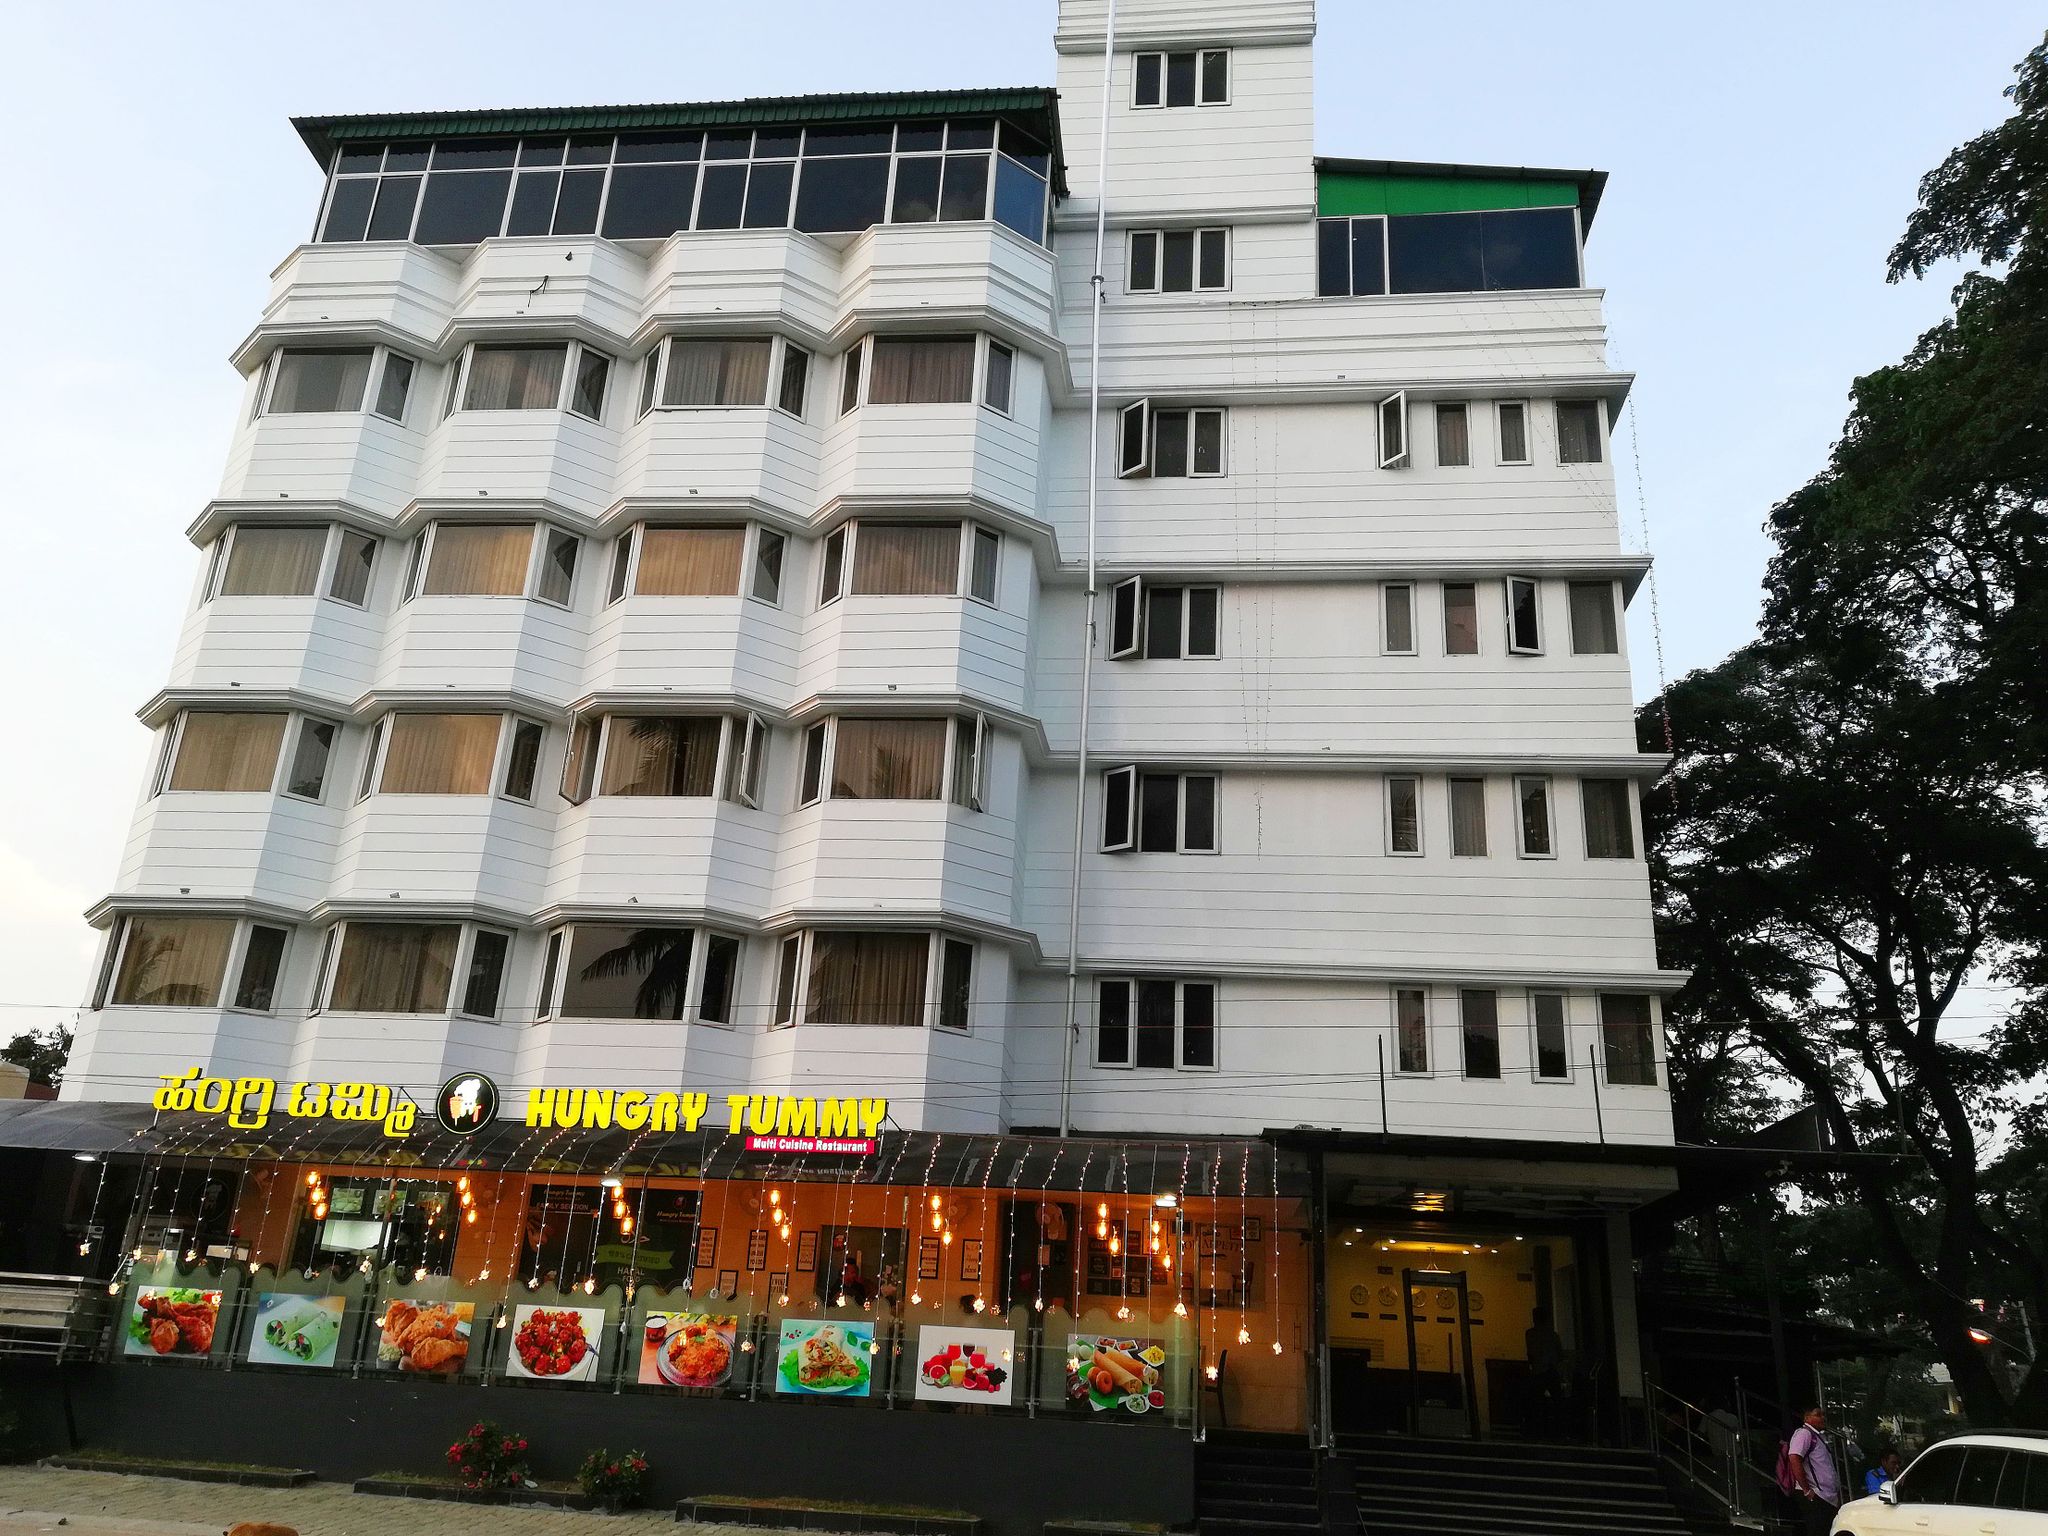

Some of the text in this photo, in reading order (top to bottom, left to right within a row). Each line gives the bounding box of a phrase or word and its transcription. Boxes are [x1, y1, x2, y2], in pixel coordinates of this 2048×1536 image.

[525, 1087, 888, 1138] HUNGRY TUMMY
[753, 1138, 868, 1153] Multi Cuisine Restaurant
[617, 1266, 645, 1276] HAAL
